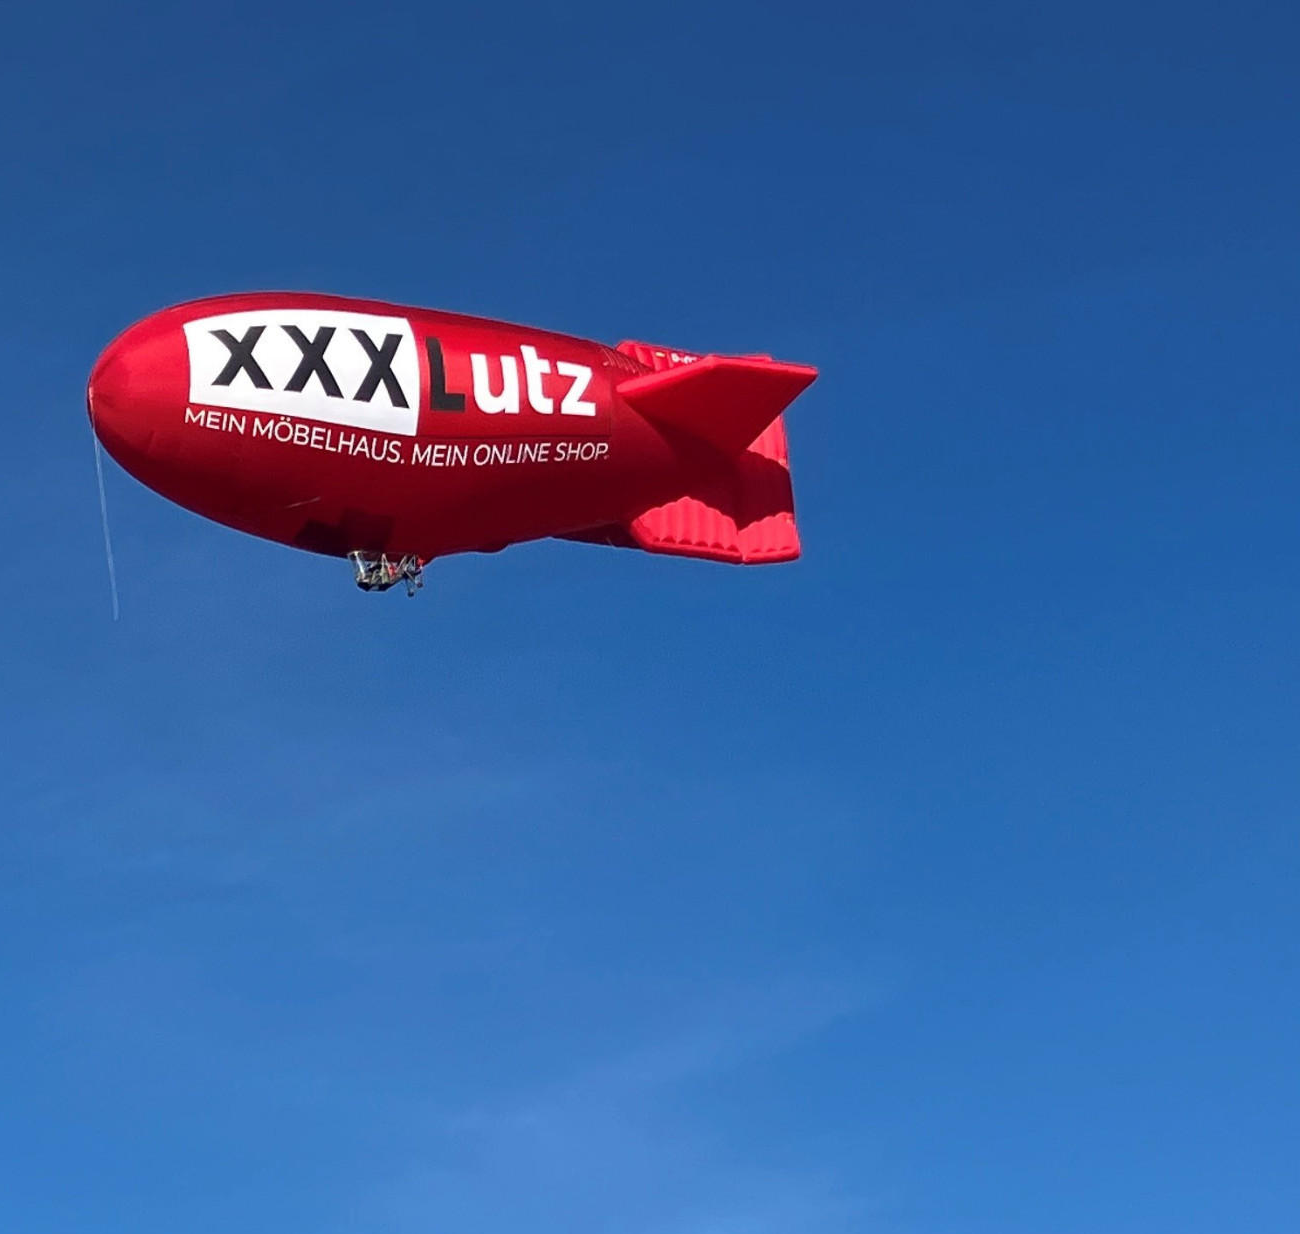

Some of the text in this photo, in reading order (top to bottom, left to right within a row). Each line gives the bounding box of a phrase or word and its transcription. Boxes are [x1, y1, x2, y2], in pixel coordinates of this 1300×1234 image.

[184, 406, 247, 435] MEIN
[252, 416, 405, 465] MÖBELHAUS.
[411, 443, 469, 467] MEIN
[473, 442, 552, 464] ONLINE
